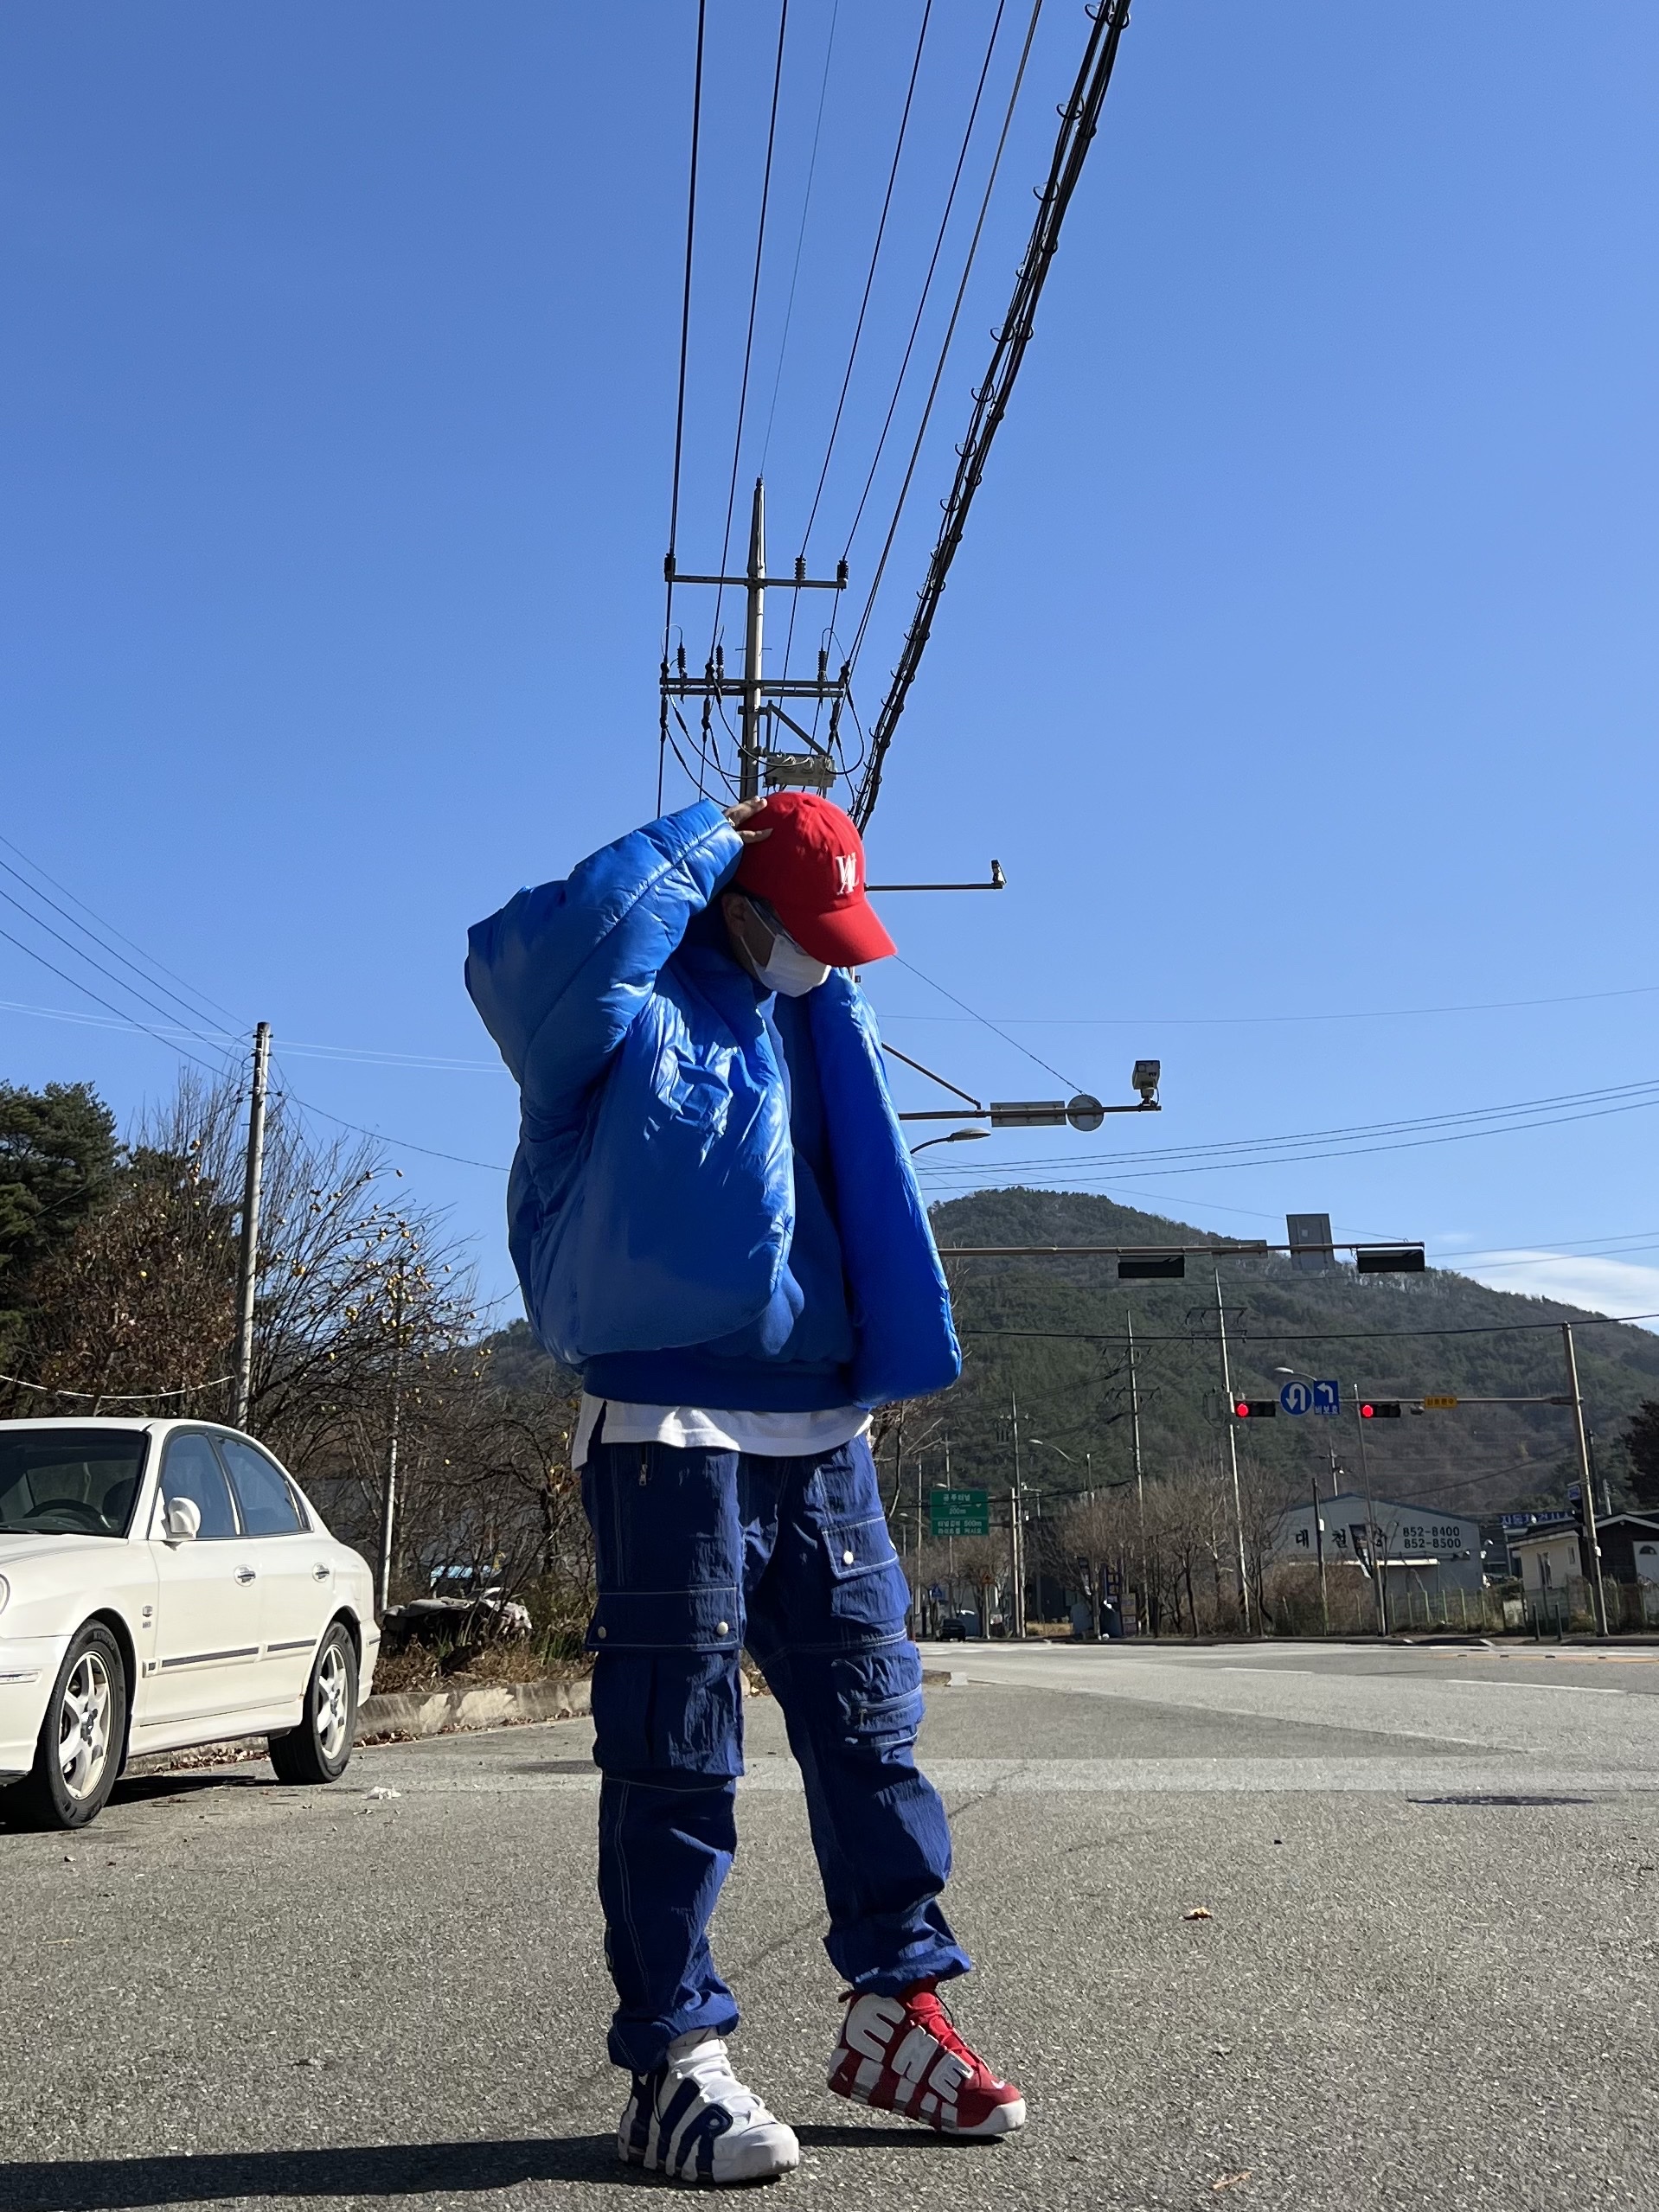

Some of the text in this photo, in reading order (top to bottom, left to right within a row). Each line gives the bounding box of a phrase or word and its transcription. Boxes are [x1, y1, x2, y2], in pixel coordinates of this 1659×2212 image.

[1314, 1404, 1339, 1415] 비보호
[1402, 1526, 1460, 1538] 852-8400
[1404, 1538, 1462, 1549] 852-8500
